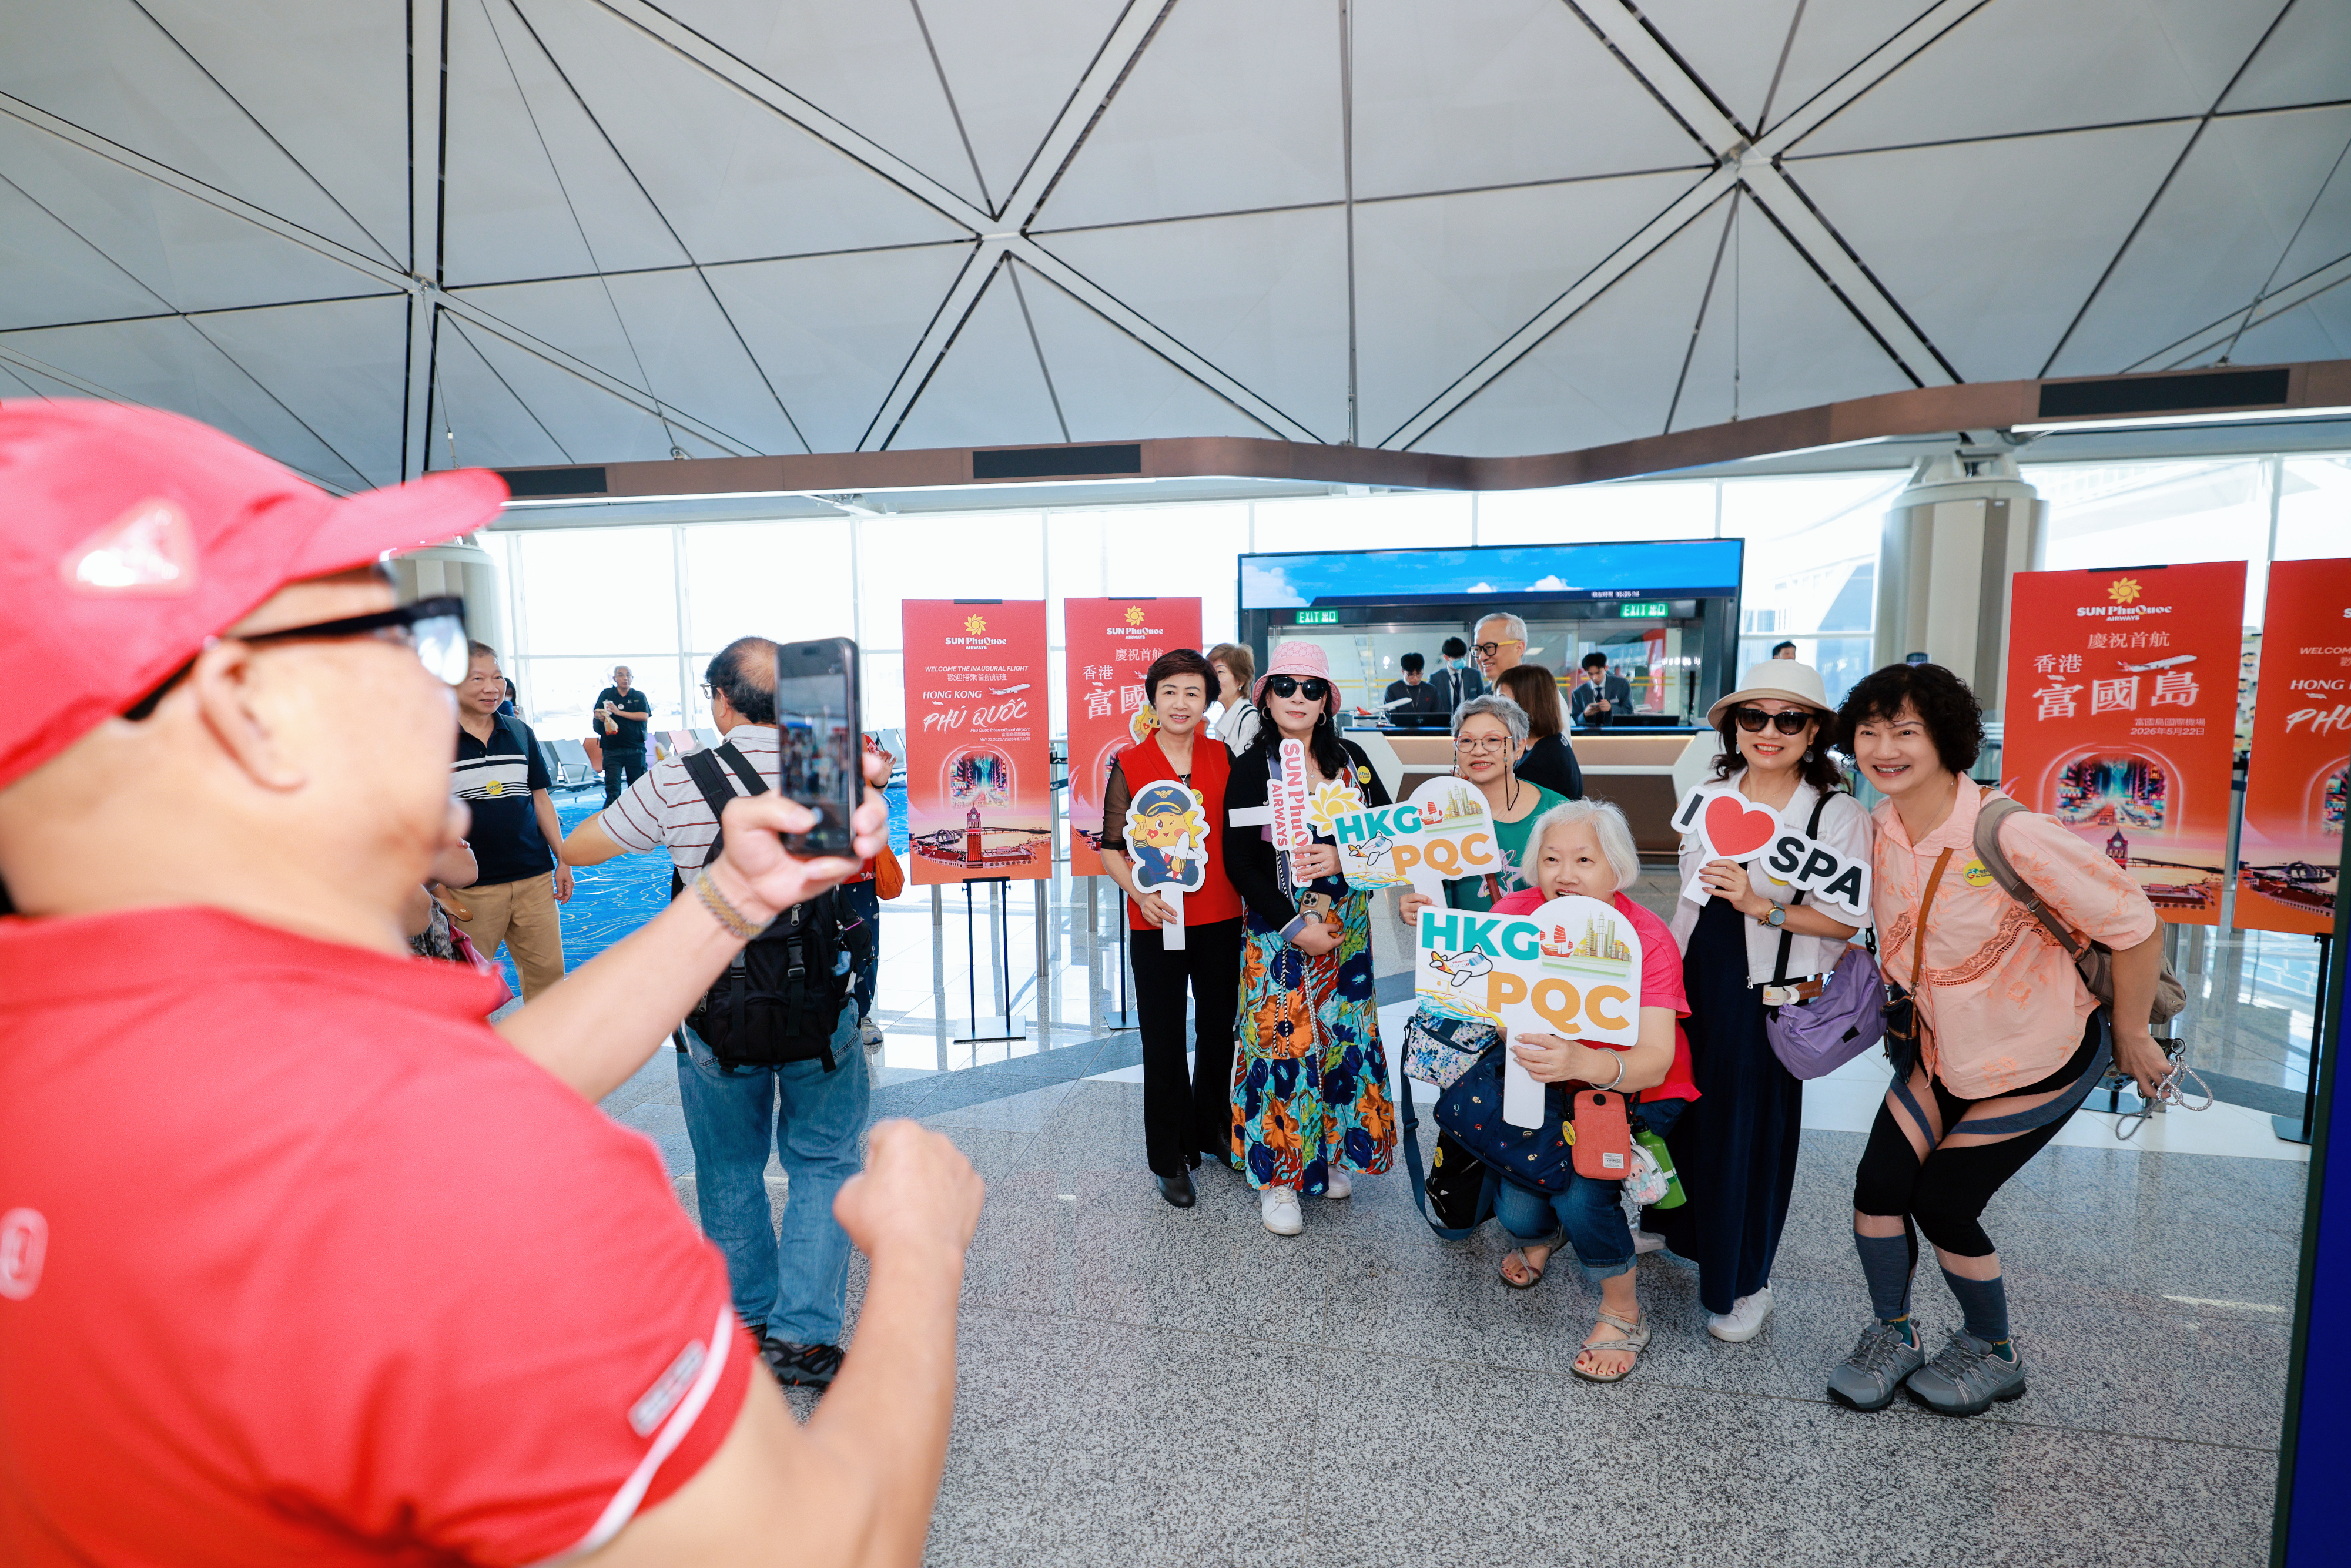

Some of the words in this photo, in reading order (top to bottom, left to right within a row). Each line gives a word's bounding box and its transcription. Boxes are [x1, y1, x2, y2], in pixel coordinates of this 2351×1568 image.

[1299, 612, 1319, 623] EXIT
[1321, 611, 1337, 622] 出口
[1623, 604, 1646, 617] EXIT
[1648, 604, 1665, 616] 出口
[2076, 607, 2106, 617] SUN
[2108, 604, 2172, 615] PhuQuoc
[966, 637, 1007, 645] PhuQuoc
[2088, 630, 2171, 649] 慶祝首航
[1115, 648, 1164, 661] 慶祝首航
[2032, 654, 2083, 674] 香港
[1083, 665, 1113, 681] 香港
[2290, 679, 2345, 690] HONG
[923, 691, 952, 699] HONG
[955, 690, 982, 698] KONG
[2032, 671, 2199, 722] 富國島
[923, 705, 967, 734] PHÚ
[972, 698, 1029, 728] QUỐC
[2135, 718, 2206, 726] 富國島國際機場
[2130, 727, 2205, 736] 2026年5月22日
[1284, 743, 1302, 786] SUN
[1272, 784, 1287, 846] AIRWAYS
[1335, 805, 1422, 844] HKG
[1391, 833, 1494, 876] PQC
[1680, 793, 1704, 827] I
[1769, 836, 1862, 907] SPA
[1422, 912, 1540, 960] HKG
[1487, 971, 1632, 1034] PQC
